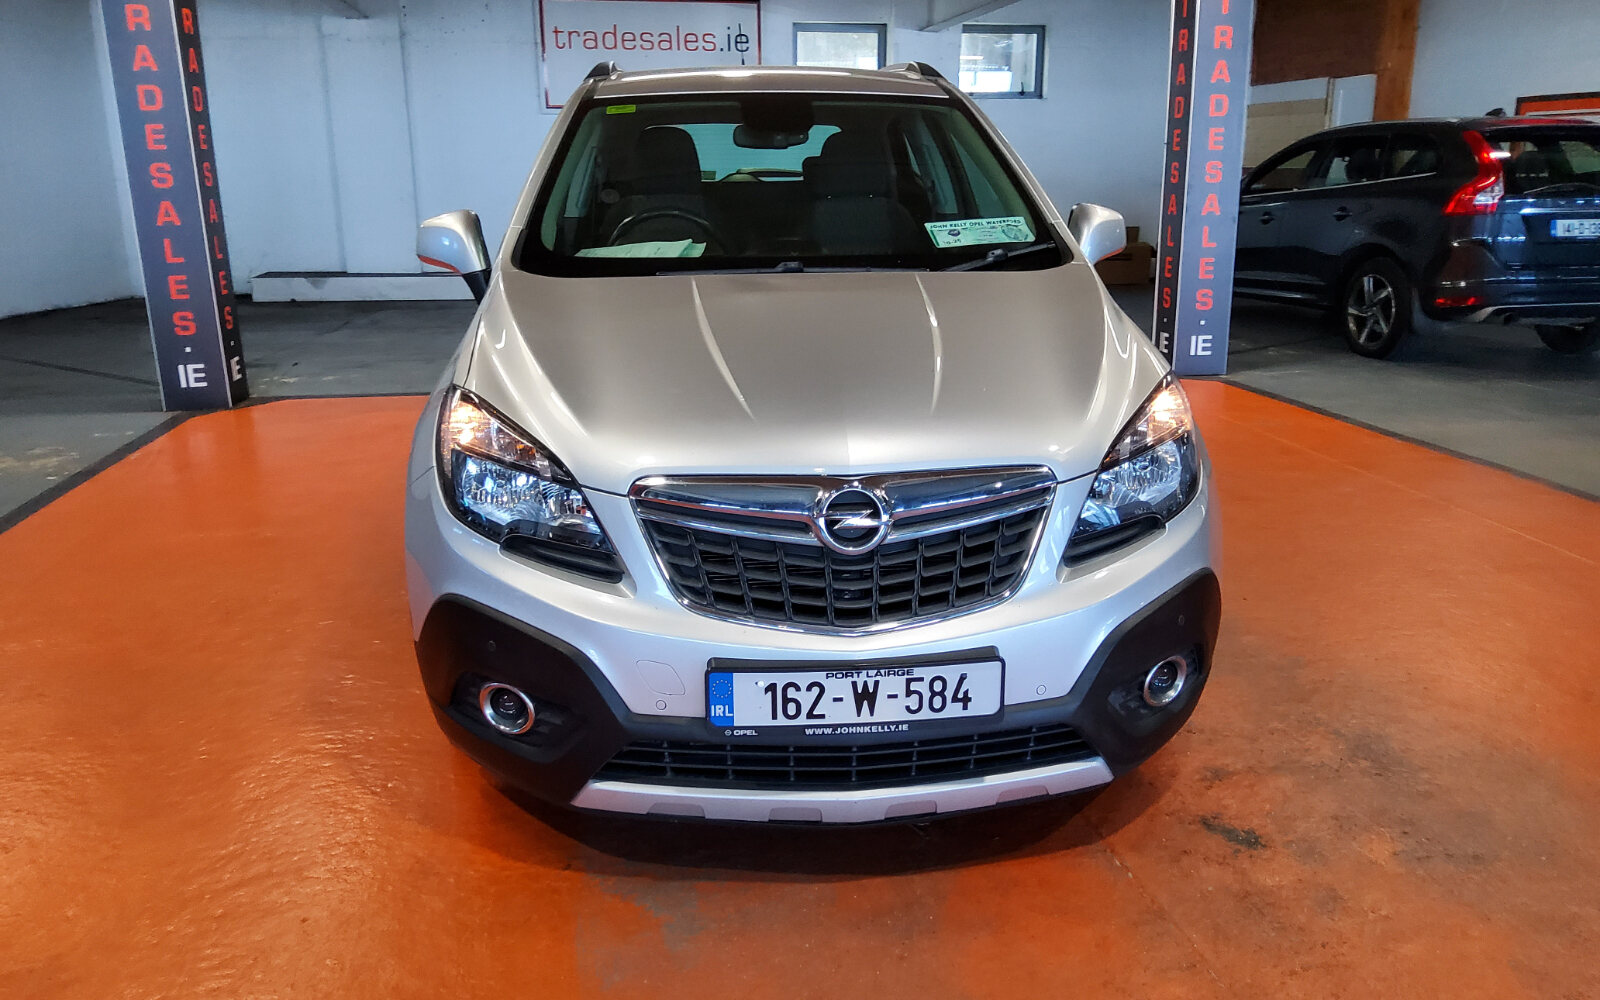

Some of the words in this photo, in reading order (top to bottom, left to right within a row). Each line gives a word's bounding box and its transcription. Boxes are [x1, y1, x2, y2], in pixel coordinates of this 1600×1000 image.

[552, 24, 750, 52] tradesales.ie
[825, 671, 863, 680] PORT
[764, 672, 972, 720] 162-W-584
[711, 704, 734, 717] IRL
[805, 724, 909, 735] WWW.JOHNKELLY.IE
